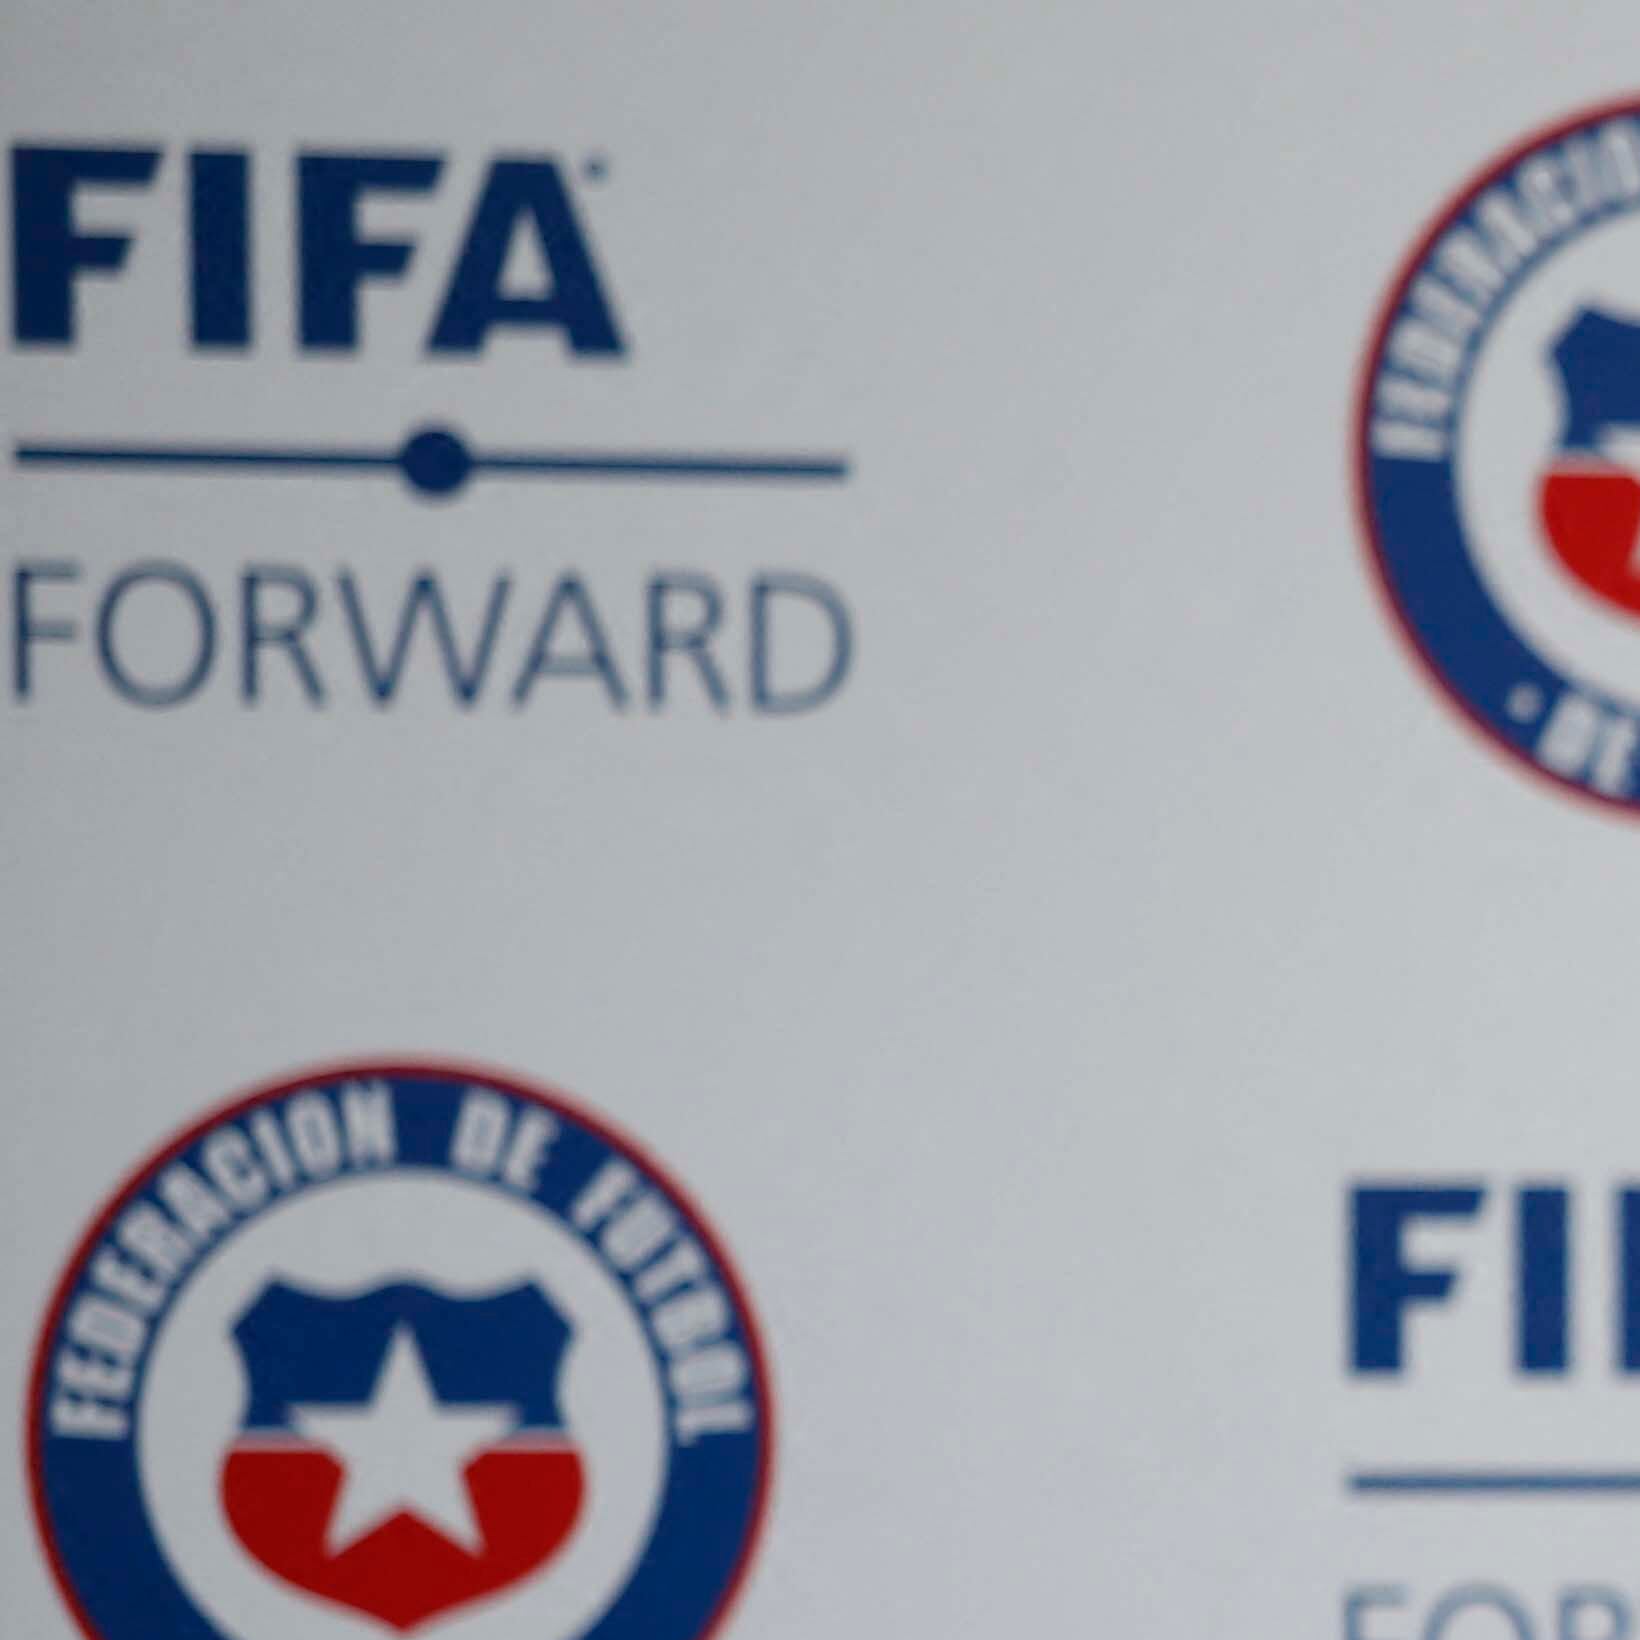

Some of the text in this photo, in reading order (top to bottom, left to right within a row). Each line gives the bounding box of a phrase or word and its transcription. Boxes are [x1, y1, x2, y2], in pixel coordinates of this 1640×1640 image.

[9, 143, 631, 361] FIFA
[9, 558, 854, 715] FORWARD
[48, 1076, 755, 1446] FEDERACION DE FUTBOL
